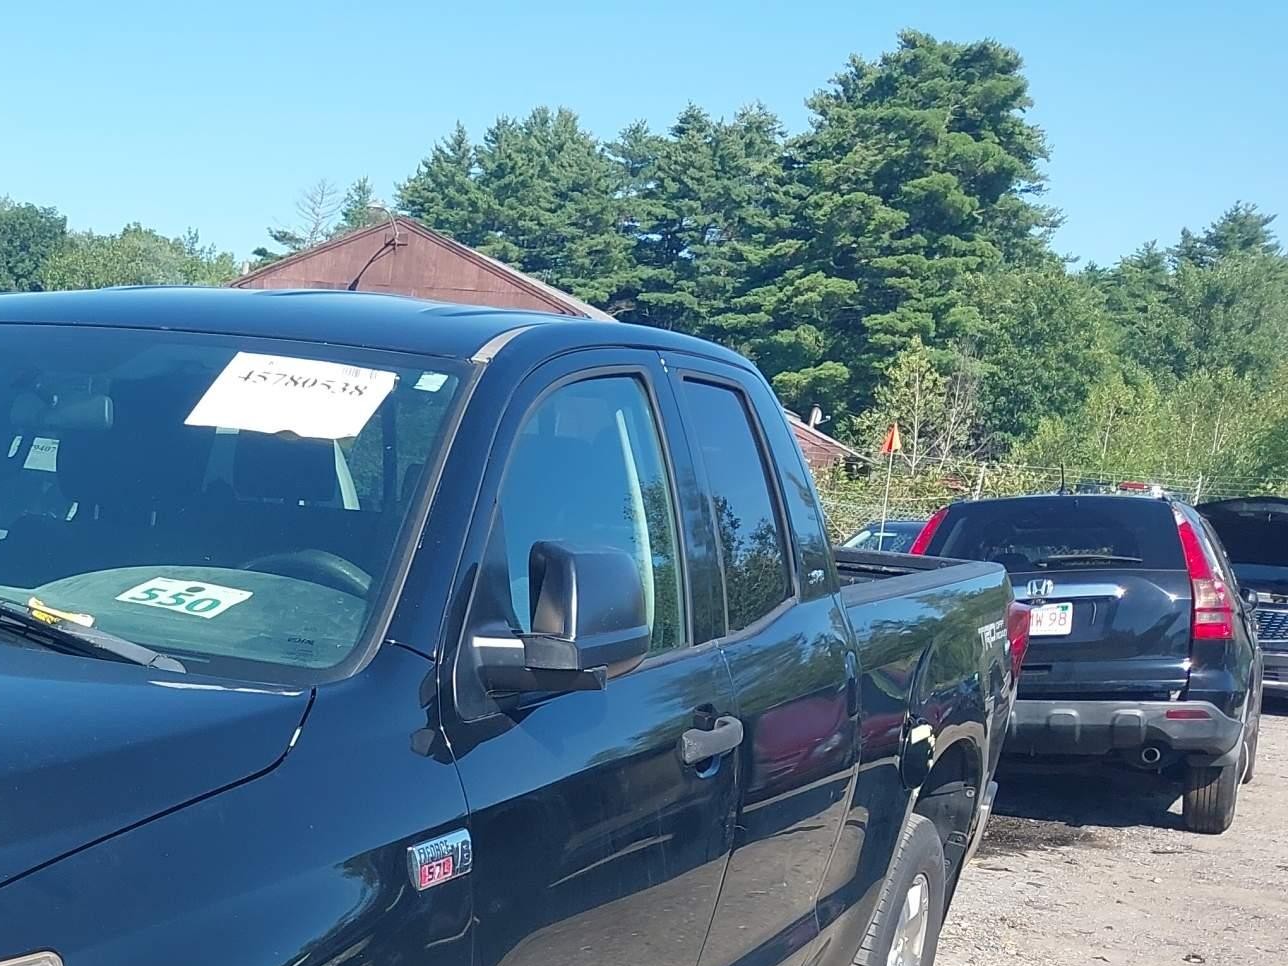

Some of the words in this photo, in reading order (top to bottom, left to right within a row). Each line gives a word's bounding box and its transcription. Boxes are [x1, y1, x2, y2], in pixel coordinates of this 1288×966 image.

[237, 369, 368, 397] 45780538
[128, 586, 222, 613] 550
[1048, 611, 1067, 627] 98
